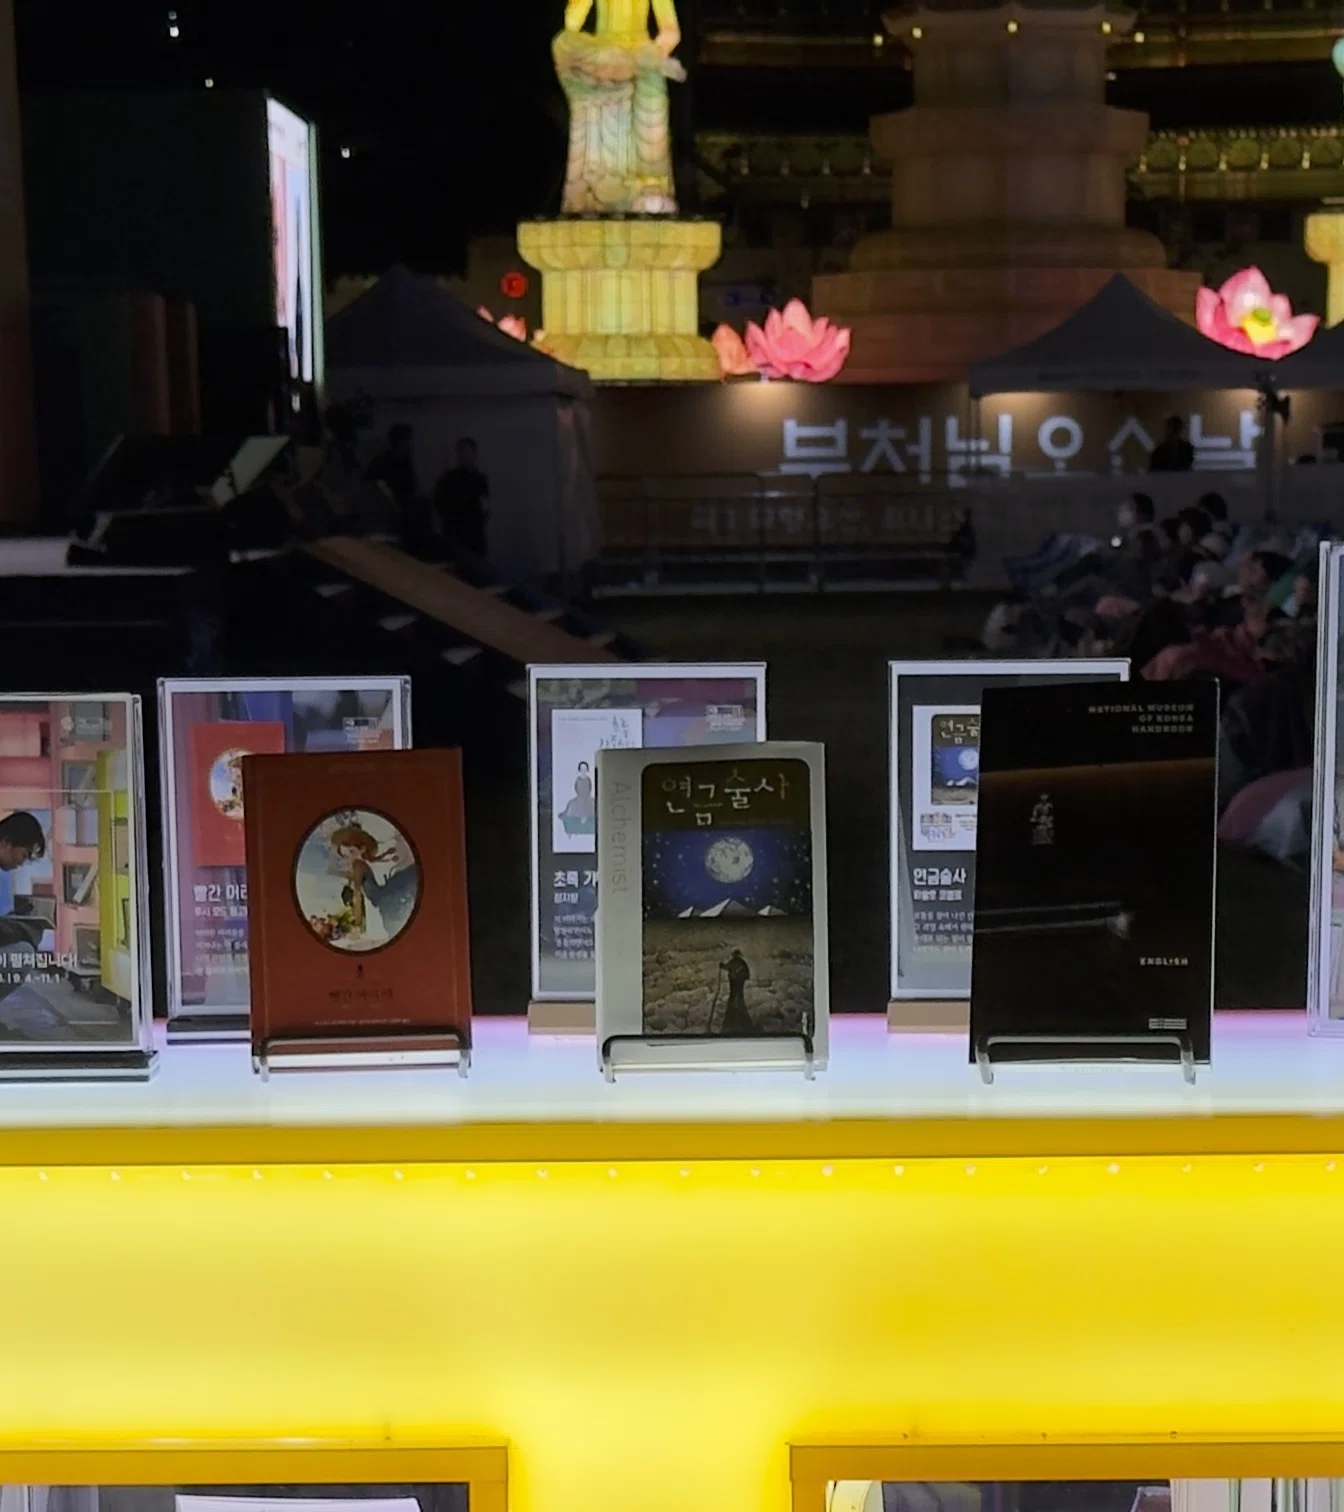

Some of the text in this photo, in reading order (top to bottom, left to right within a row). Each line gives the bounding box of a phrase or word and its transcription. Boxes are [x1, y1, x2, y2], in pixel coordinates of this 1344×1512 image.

[1088, 703, 1195, 714] NATIONAL MUSEUM
[1138, 714, 1194, 723] OF KOREA
[939, 717, 980, 745] 연금술
[660, 766, 790, 827] 연금술사
[611, 781, 633, 896] Alchemist
[553, 870, 579, 888] 초록
[913, 867, 967, 886] 연금술사
[193, 884, 222, 902] 빨간
[1139, 956, 1189, 967] ENGLISH
